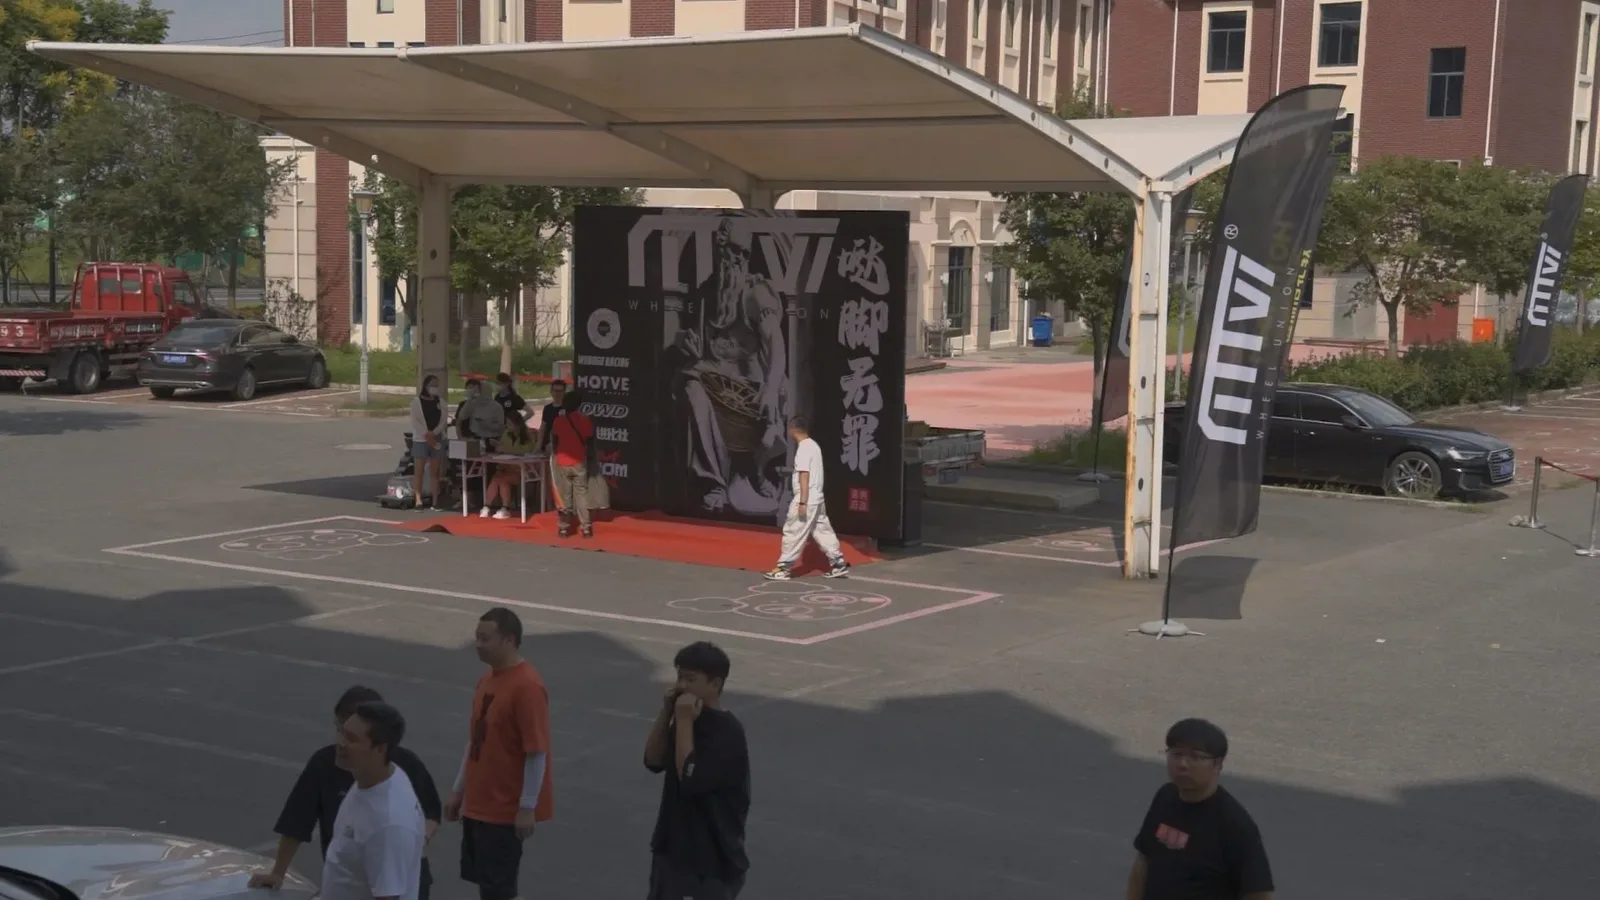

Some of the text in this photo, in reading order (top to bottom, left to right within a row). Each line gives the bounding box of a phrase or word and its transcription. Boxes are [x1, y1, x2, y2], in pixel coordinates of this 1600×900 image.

[1256, 365, 1277, 439] WHEEL
[1273, 267, 1296, 347] UNION
[577, 375, 630, 391] MOTVE
[581, 402, 629, 419] DWD
